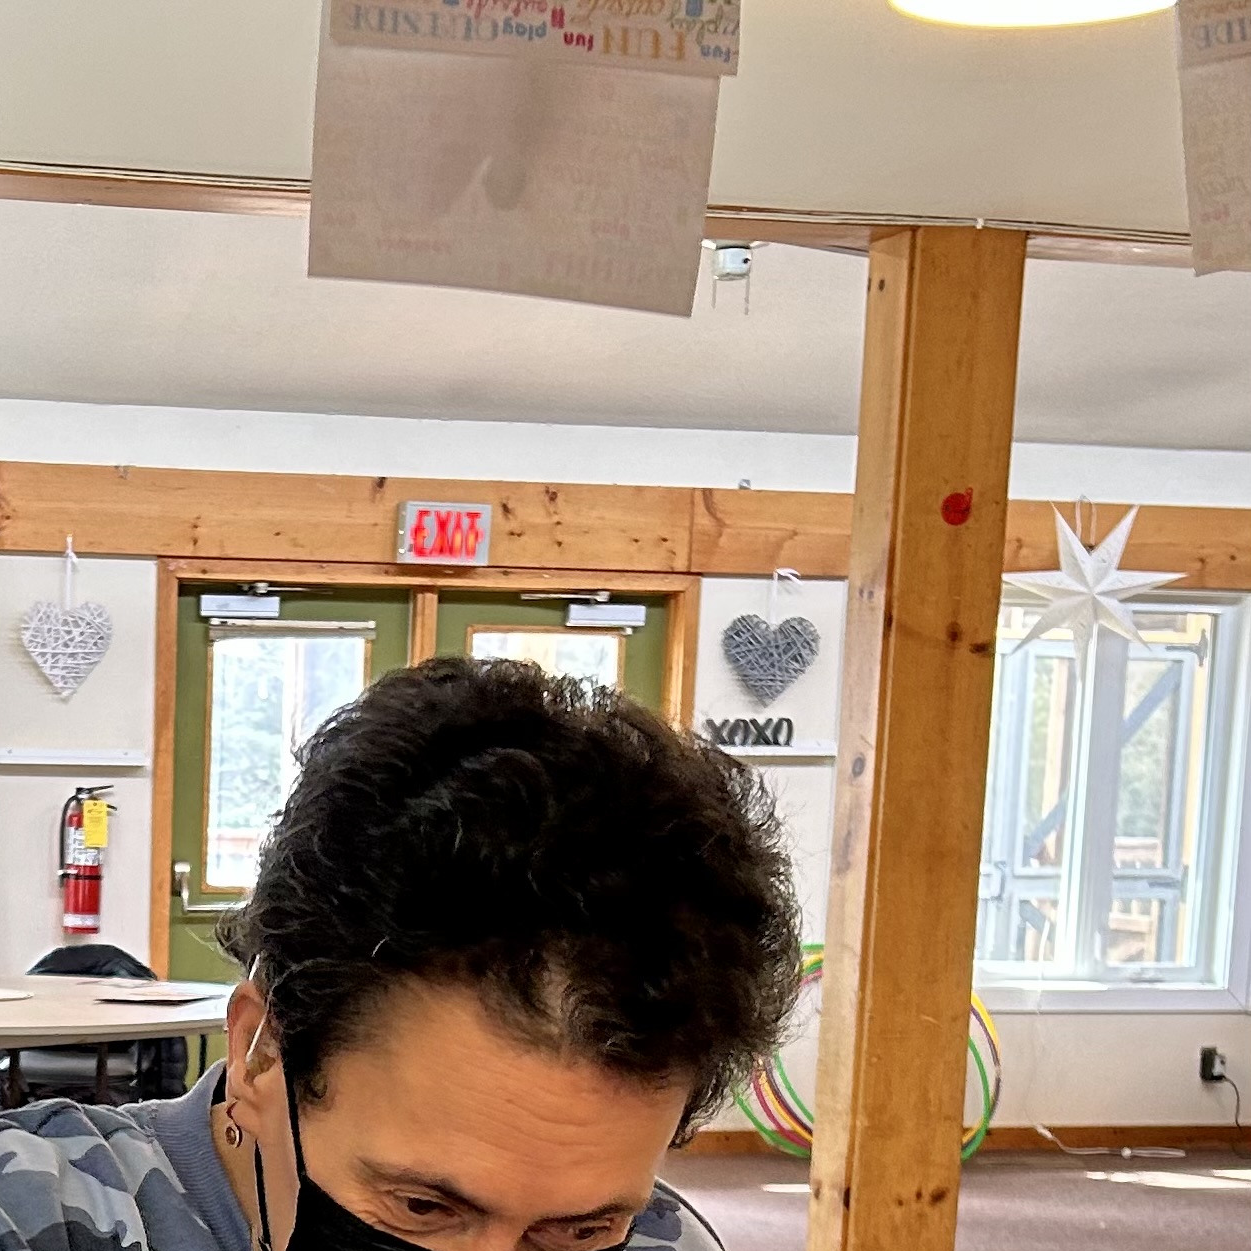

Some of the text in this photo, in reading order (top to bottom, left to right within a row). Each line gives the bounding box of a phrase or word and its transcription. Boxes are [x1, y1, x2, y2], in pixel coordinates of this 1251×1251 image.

[503, 16, 548, 41] play
[563, 31, 595, 52] fun
[603, 25, 686, 61] FUN
[700, 44, 732, 63] fun
[411, 509, 483, 559] EXIT
[706, 717, 794, 748] XOXO
